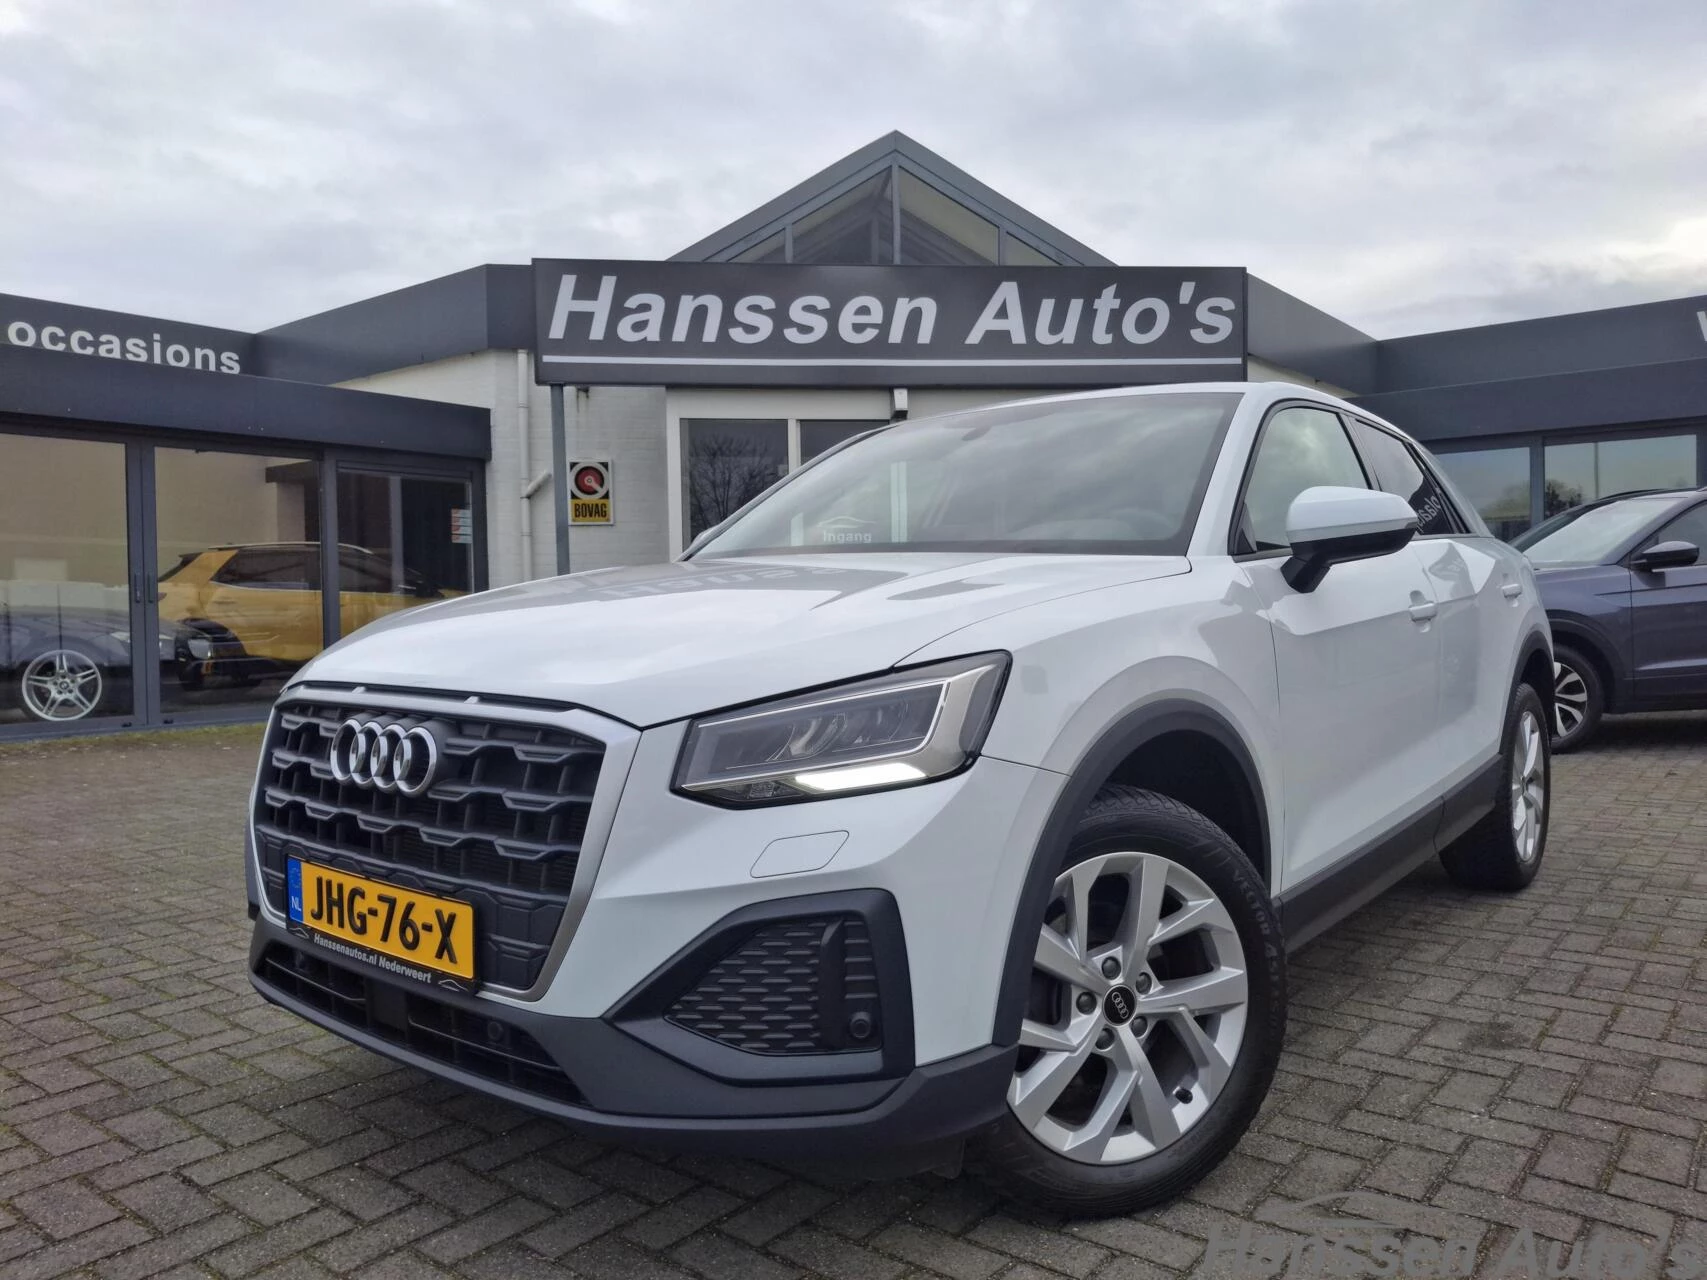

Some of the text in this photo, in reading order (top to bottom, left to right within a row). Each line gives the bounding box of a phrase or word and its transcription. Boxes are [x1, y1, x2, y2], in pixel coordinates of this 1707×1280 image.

[548, 273, 1235, 346] Hanssen Auto's
[7, 320, 241, 376] occasions
[574, 503, 608, 518] BOVAG
[823, 530, 872, 545] Ingang
[291, 895, 301, 911] NL
[311, 877, 457, 964] JHG-76-X
[313, 932, 432, 984] Hanssenautos.nl Nederweert
